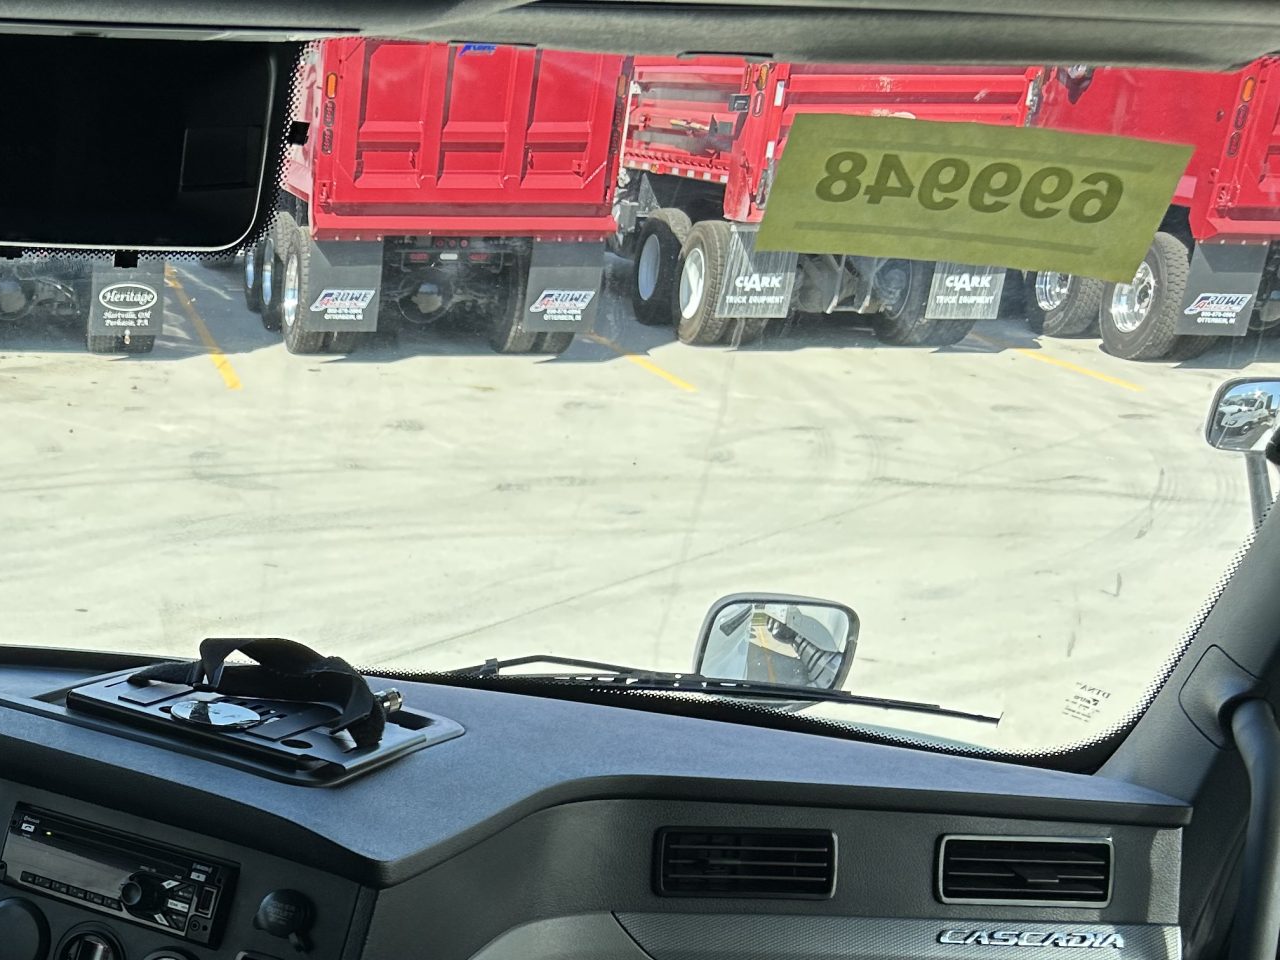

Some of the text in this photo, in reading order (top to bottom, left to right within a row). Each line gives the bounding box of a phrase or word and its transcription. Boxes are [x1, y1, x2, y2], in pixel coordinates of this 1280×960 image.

[735, 273, 783, 292] CLARK
[945, 273, 992, 292] CLARK
[103, 290, 154, 305] Heritage
[332, 291, 372, 302] ROWE
[552, 293, 592, 303] ROWE
[725, 295, 785, 305] TRUCK EQUIPMENT
[936, 295, 995, 305] TRUCK EQUIPMENT
[1206, 295, 1248, 306] ROWE
[936, 928, 1125, 949] CASCADIA
